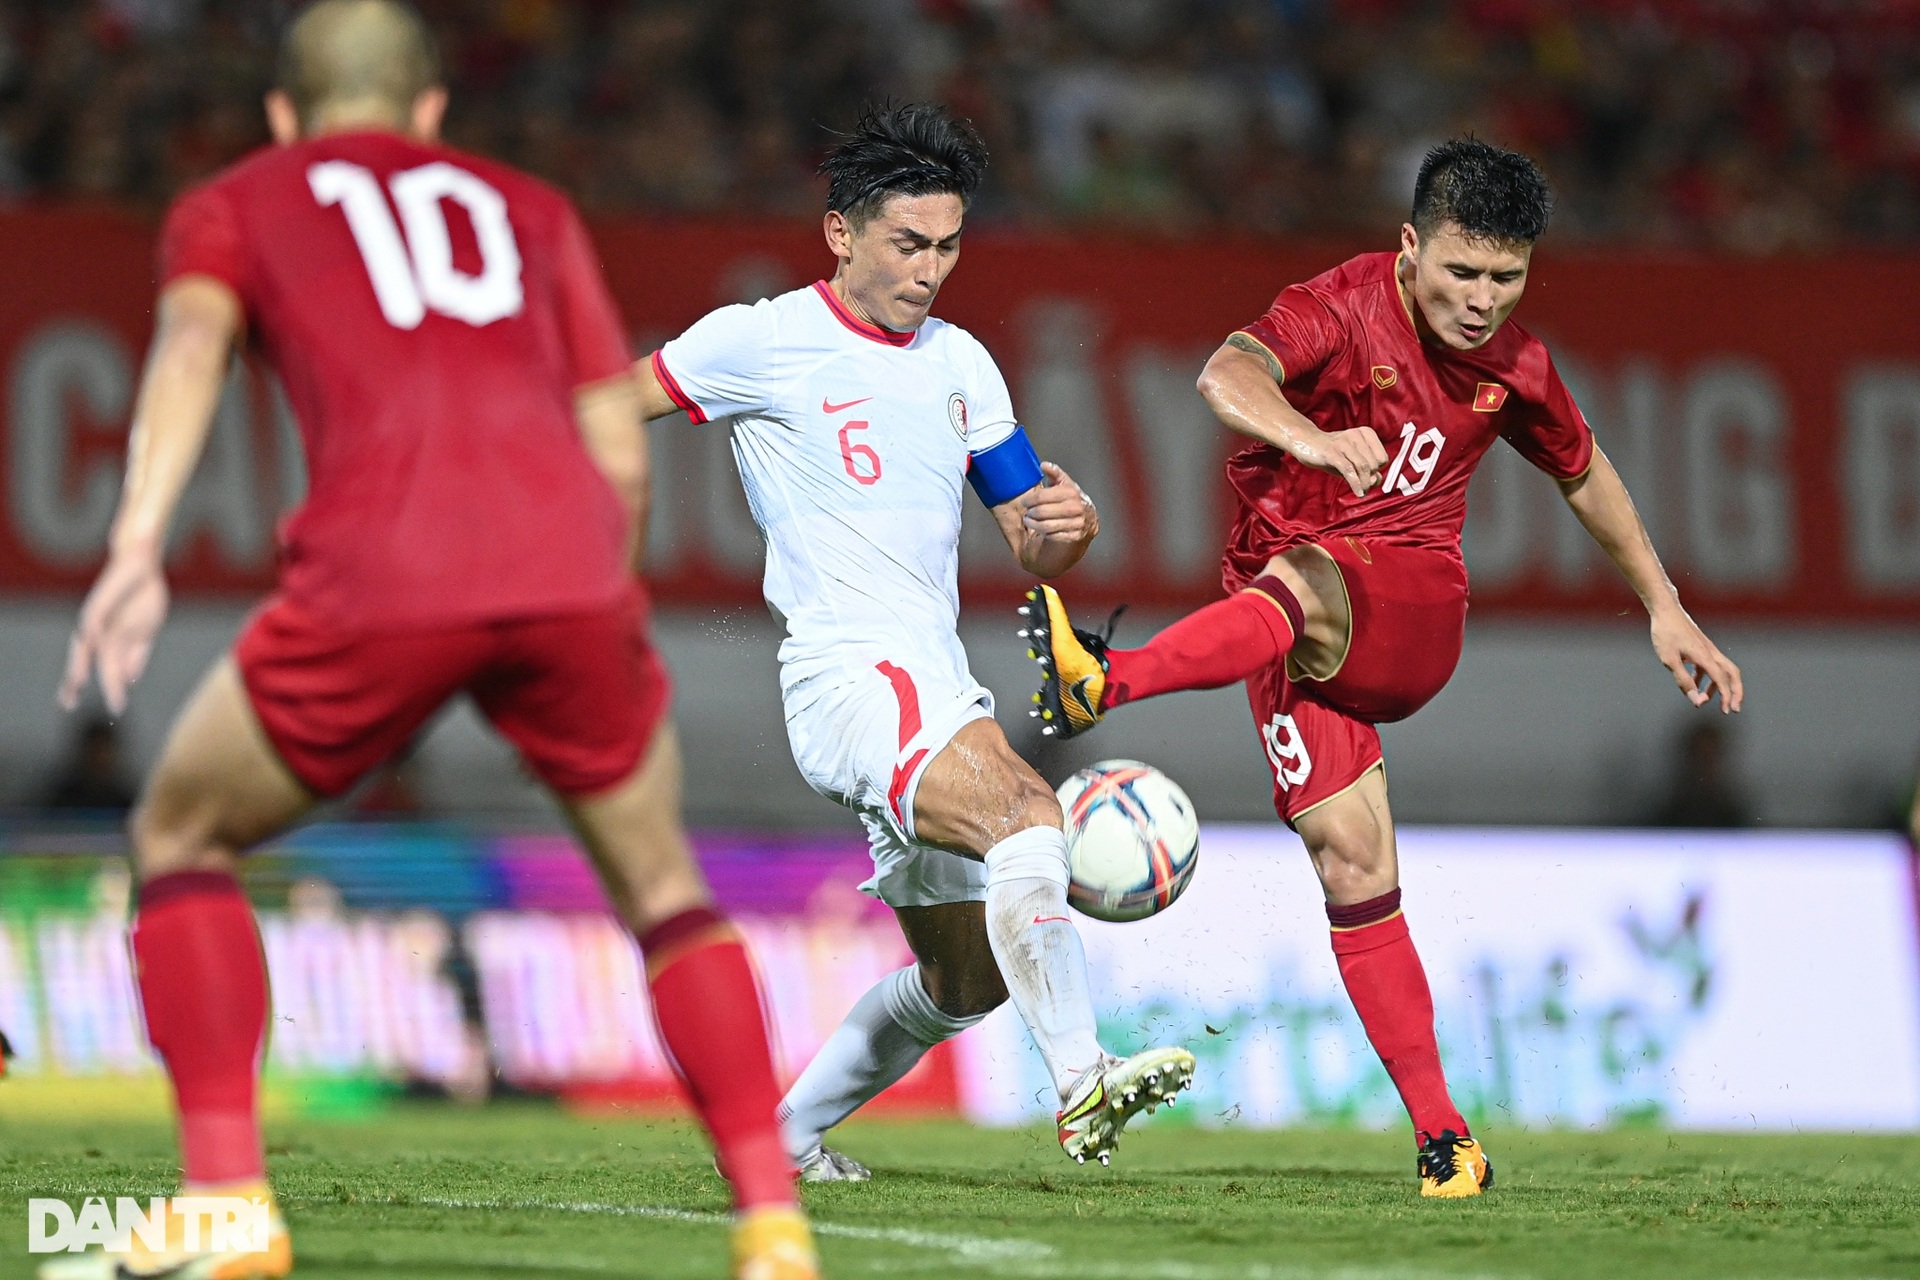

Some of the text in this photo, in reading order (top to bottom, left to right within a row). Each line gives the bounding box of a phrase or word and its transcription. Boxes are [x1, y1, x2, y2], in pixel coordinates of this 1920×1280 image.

[306, 159, 525, 331] 10
[838, 420, 882, 485] 6
[1381, 421, 1447, 497] 19
[1261, 712, 1313, 793] 19
